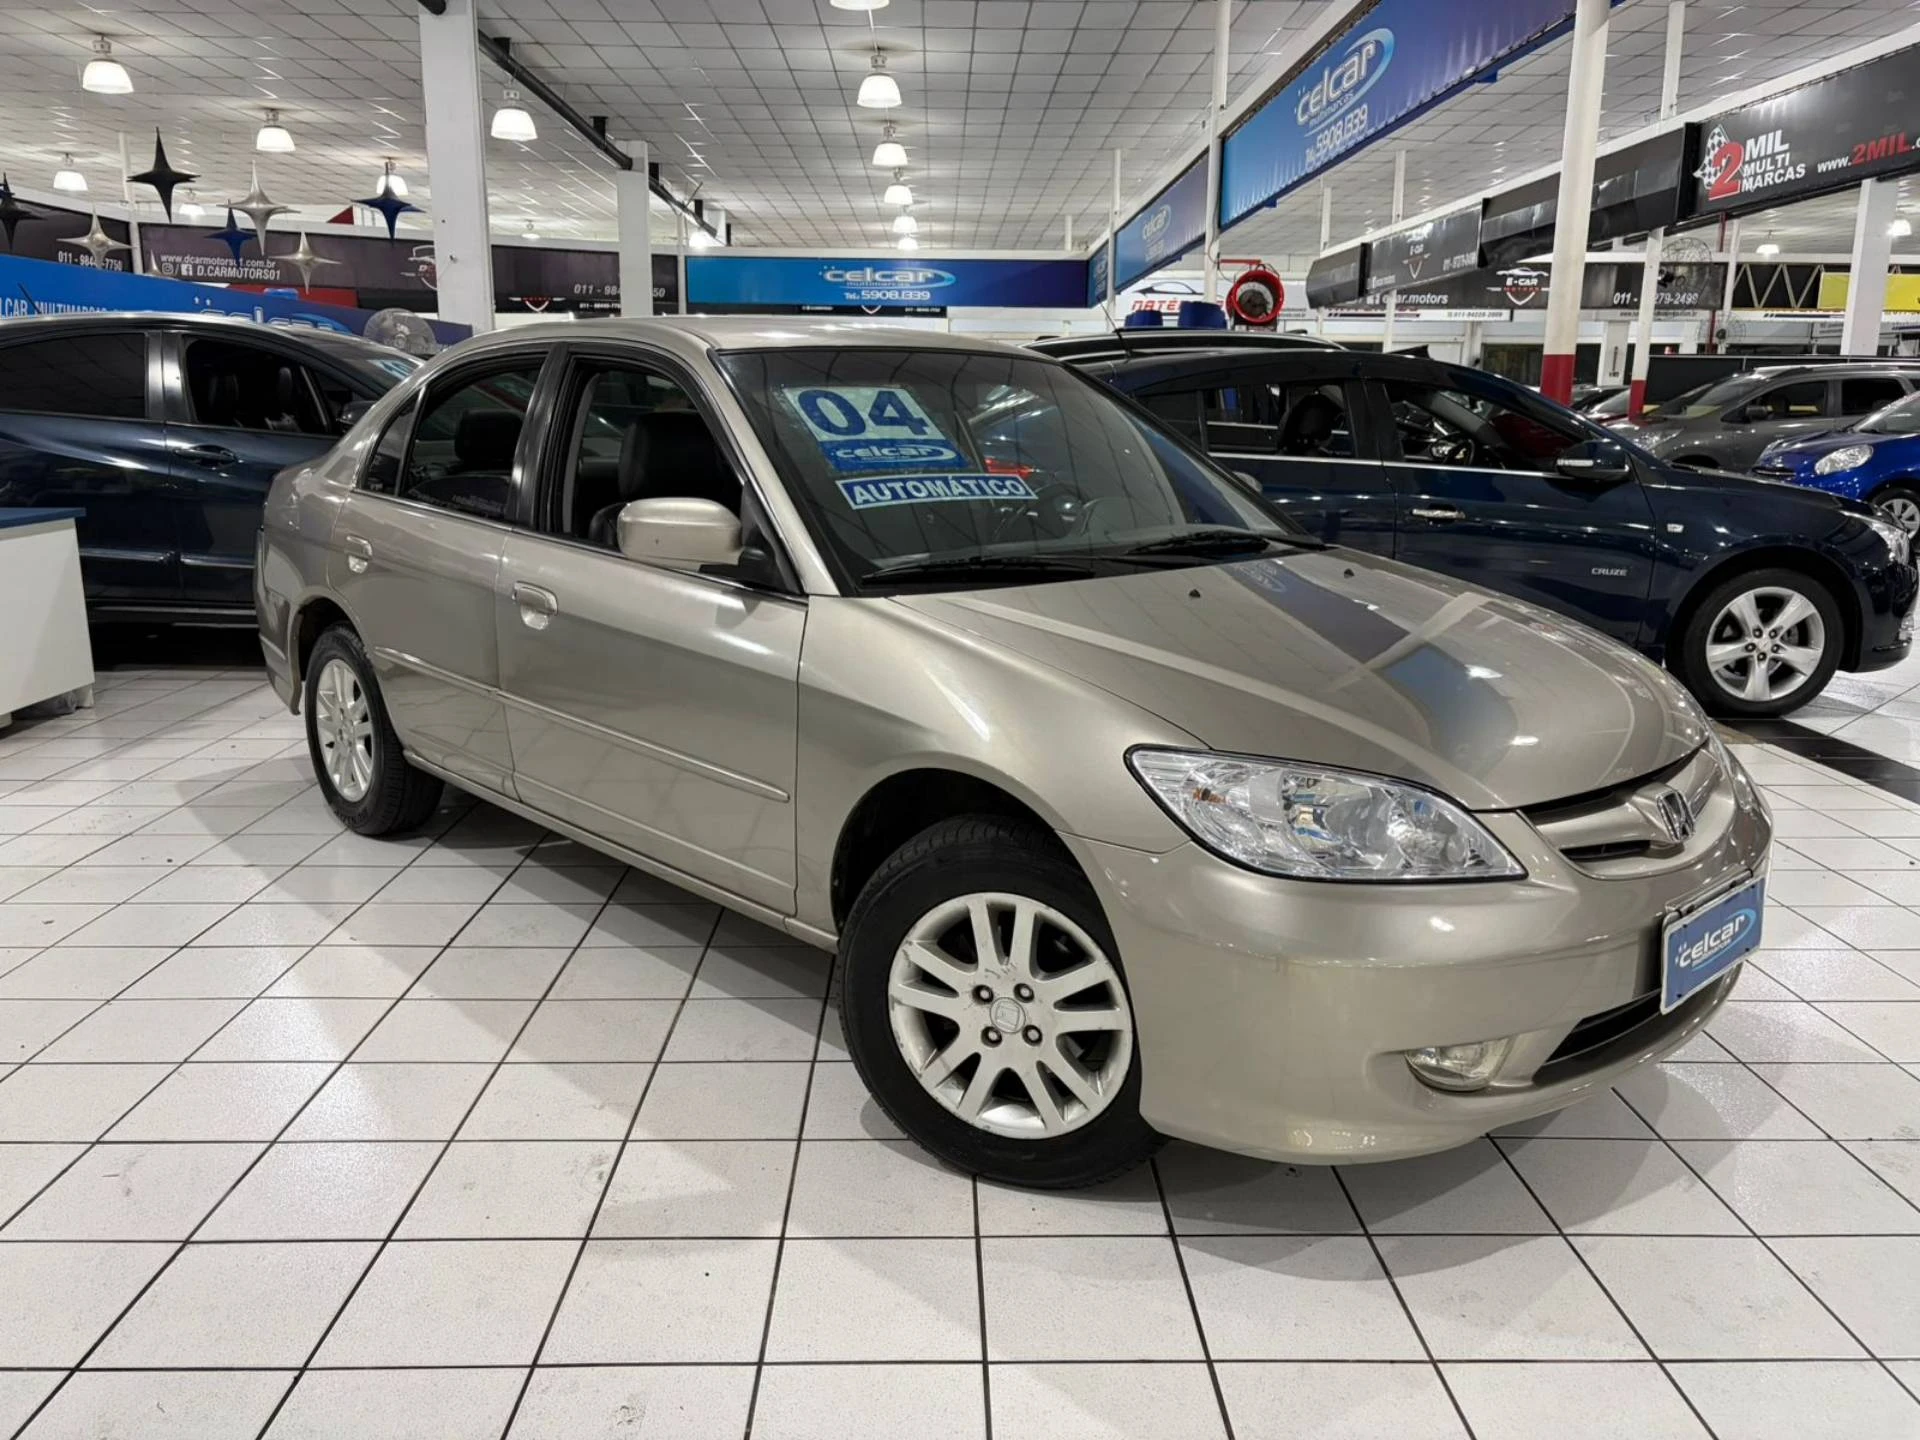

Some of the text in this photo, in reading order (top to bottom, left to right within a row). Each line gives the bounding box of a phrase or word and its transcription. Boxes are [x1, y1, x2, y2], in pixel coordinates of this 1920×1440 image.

[1296, 40, 1376, 125] celcar
[1709, 129, 1790, 201] 2 MIL
[1744, 152, 1790, 176] MULTI
[1741, 163, 1806, 193] MARCAS
[57, 251, 72, 264] 011
[80, 254, 123, 272] 984-7750
[161, 254, 276, 268] www.dcarmotors1.com.br
[197, 265, 280, 280] D.CARMOTORS01
[824, 267, 934, 282] celcar
[1506, 277, 1538, 286] E-CAR
[574, 284, 593, 294] 011
[1613, 291, 1631, 305] 011
[798, 389, 929, 436] 04
[836, 446, 932, 457] celcar
[853, 476, 1027, 504] AUTOMÁTICO
[1592, 568, 1628, 576] CRUZE
[1679, 915, 1745, 968] celcar
